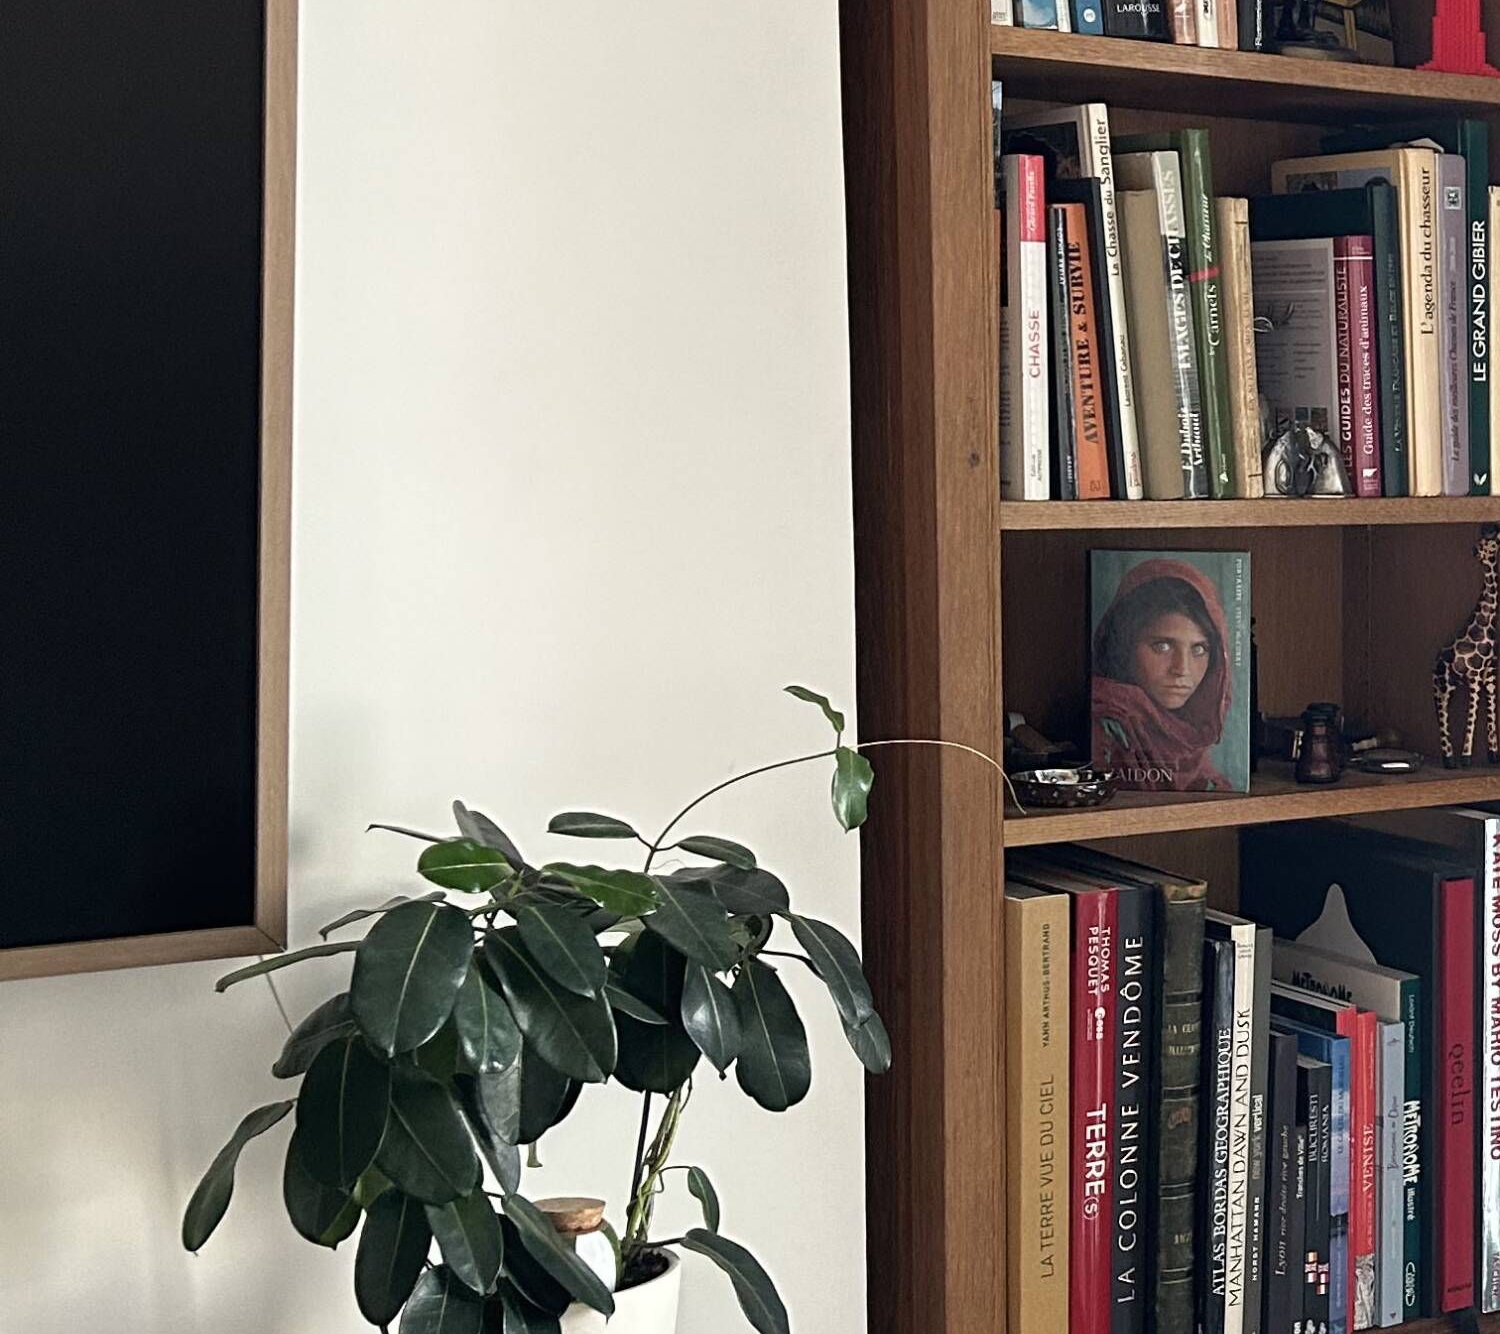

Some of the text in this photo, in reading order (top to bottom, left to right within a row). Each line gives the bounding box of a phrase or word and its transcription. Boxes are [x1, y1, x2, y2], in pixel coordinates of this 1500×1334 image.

[1116, 3, 1161, 14] LAROUSSE
[1095, 118, 1120, 277] La Chasse du Sanglier
[1169, 260, 1185, 291] DE
[1419, 167, 1435, 335] L'agenda du chasseur
[1029, 309, 1041, 379] CHASSE
[1068, 241, 1099, 444] AVENTURE & SURVIE
[1172, 293, 1192, 370] IMAGES
[1336, 266, 1350, 358] NATURALISTE
[1471, 220, 1487, 382] LE GRAND GIBIER
[1338, 362, 1351, 384] DU
[1339, 387, 1352, 441] GUIDES
[1357, 284, 1374, 455] Guide des traces d'animaux
[1087, 926, 1099, 996] PESQUET
[1100, 926, 1111, 993] THOMAS
[1039, 922, 1055, 1279] LA TERRE VUE DU CIEL YANN ARTHUS-BERTRAND
[1117, 936, 1144, 1304] LA COLONNE VENDÔME
[1212, 1027, 1232, 1296] ATLAS BORDAS GEOGRAPHIQUE
[1227, 1008, 1251, 1308] MANHATTAN DAWN AND DUSK
[1362, 1123, 1375, 1193] VENISE
